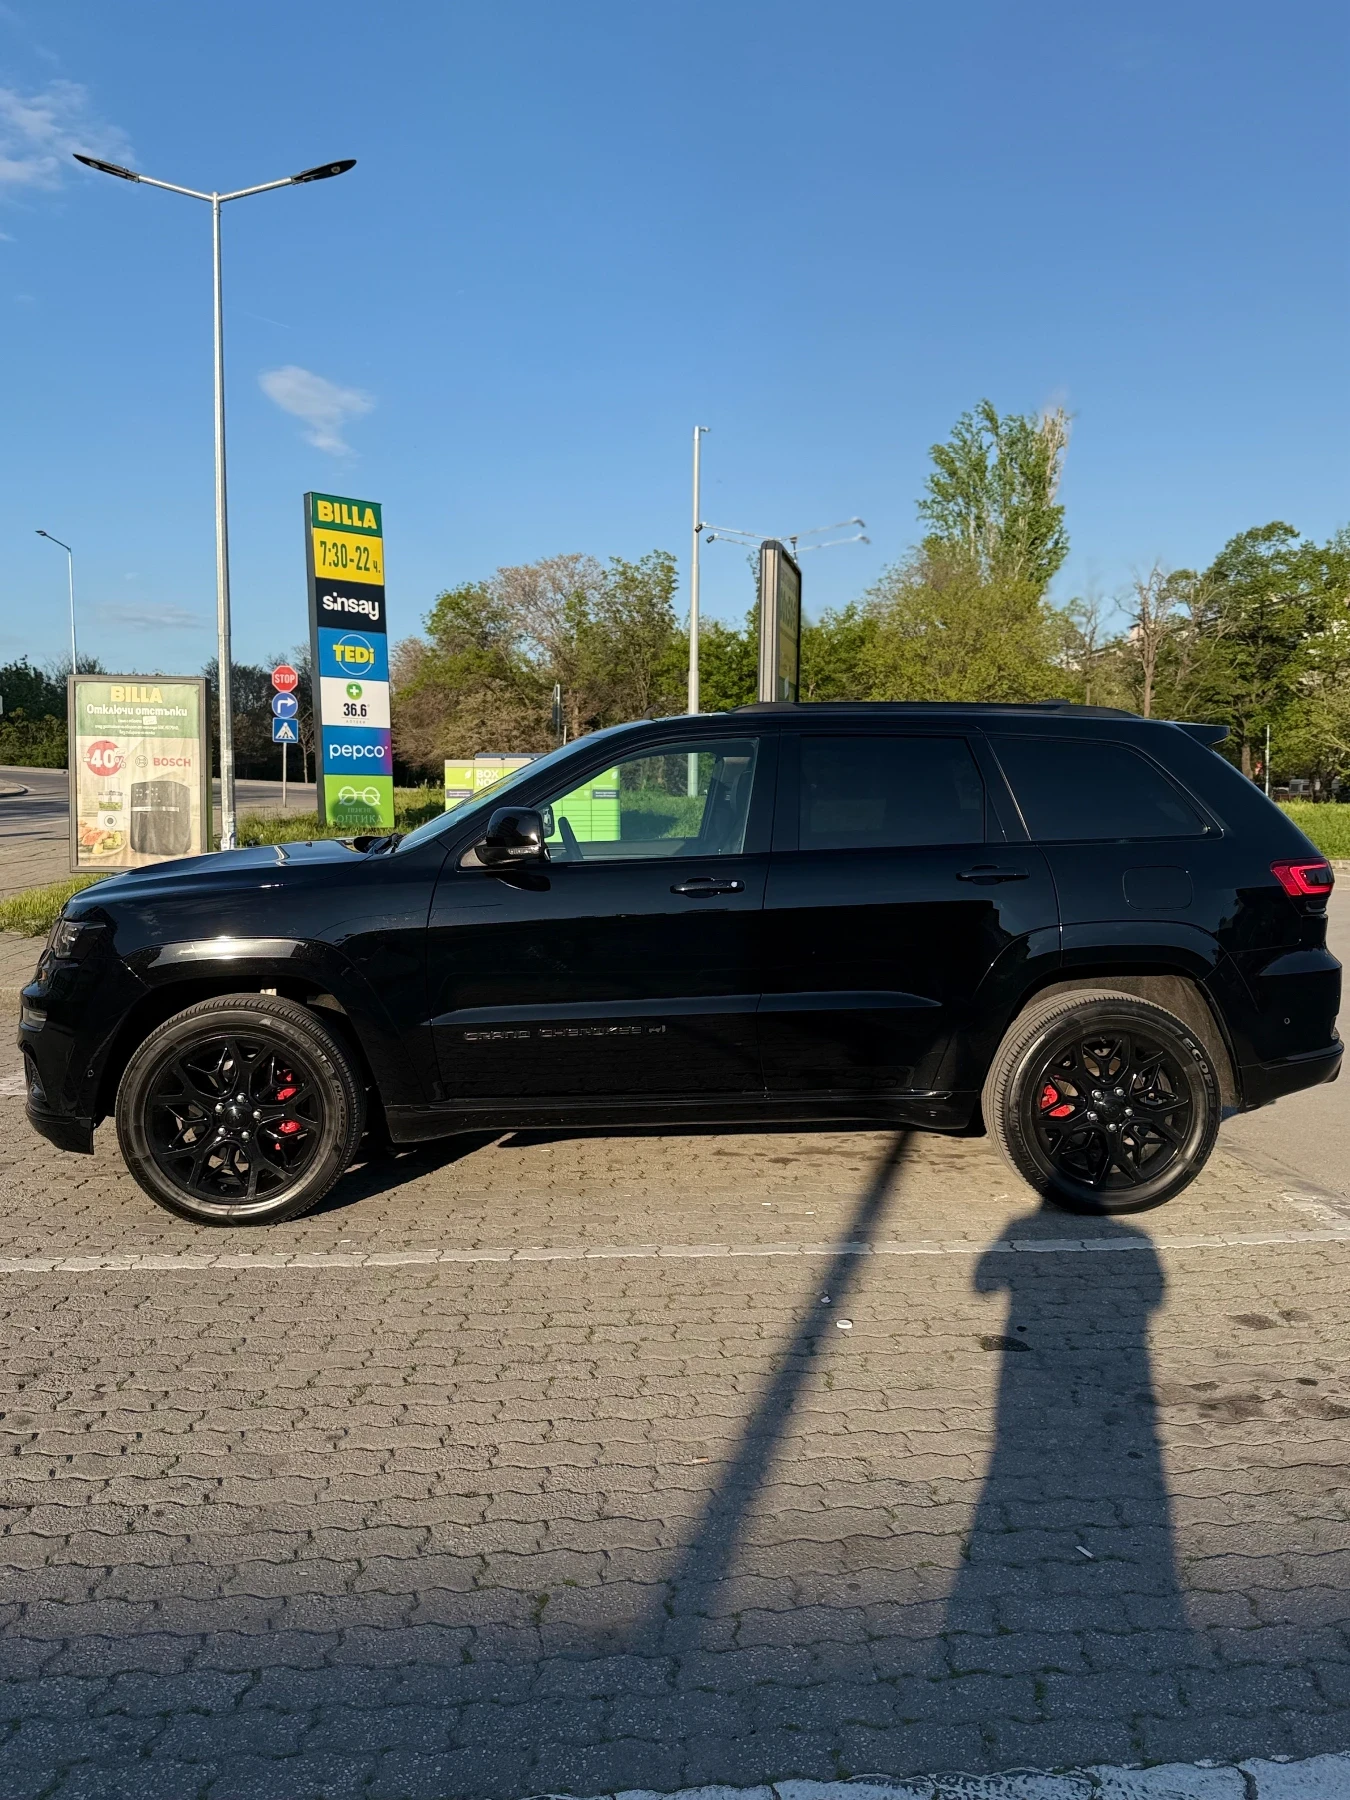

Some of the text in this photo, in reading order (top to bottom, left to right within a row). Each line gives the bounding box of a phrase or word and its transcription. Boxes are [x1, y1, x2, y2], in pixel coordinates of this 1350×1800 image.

[317, 500, 378, 530] BILLA
[319, 540, 371, 572] 7:30-22
[322, 592, 380, 621] sinsay
[332, 644, 375, 665] TEDi
[274, 673, 296, 684] STOP
[110, 685, 163, 704] BILLA
[86, 703, 188, 717] Отключи отстъпки
[329, 743, 385, 760] pepco
[153, 757, 191, 768] BOSCH
[476, 769, 499, 778] BOX
[476, 778, 497, 787] NO
[463, 1030, 531, 1041] GRAND
[539, 1026, 642, 1038] CHEROKEE
[1181, 1037, 1217, 1109] ECOPIA
